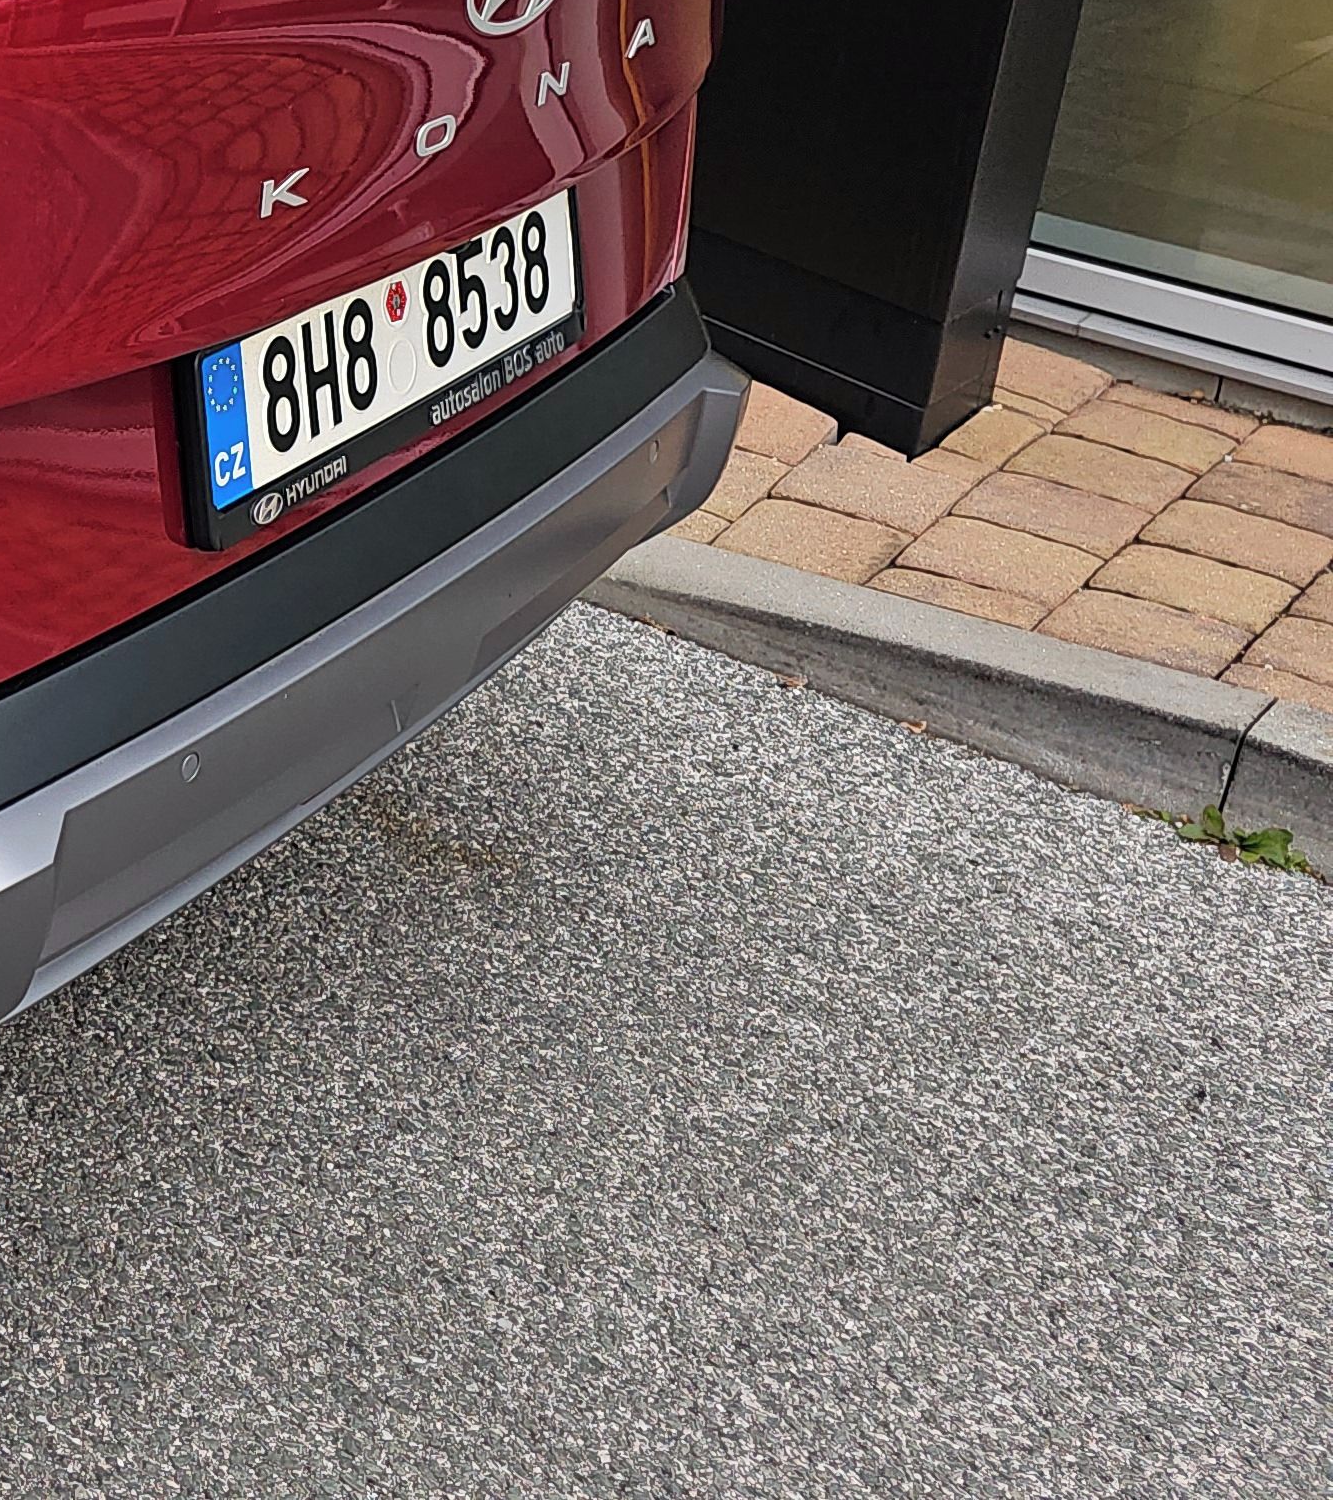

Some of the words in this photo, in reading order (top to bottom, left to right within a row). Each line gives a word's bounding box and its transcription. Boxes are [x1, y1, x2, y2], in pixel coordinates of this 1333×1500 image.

[260, 17, 656, 219] KONA
[262, 297, 378, 454] 8H8
[422, 210, 549, 369] 8538
[431, 368, 502, 426] autosalon
[503, 343, 533, 385] BOS
[536, 330, 566, 365] auto
[214, 441, 248, 487] CZ
[285, 455, 348, 507] HYUNDAI
